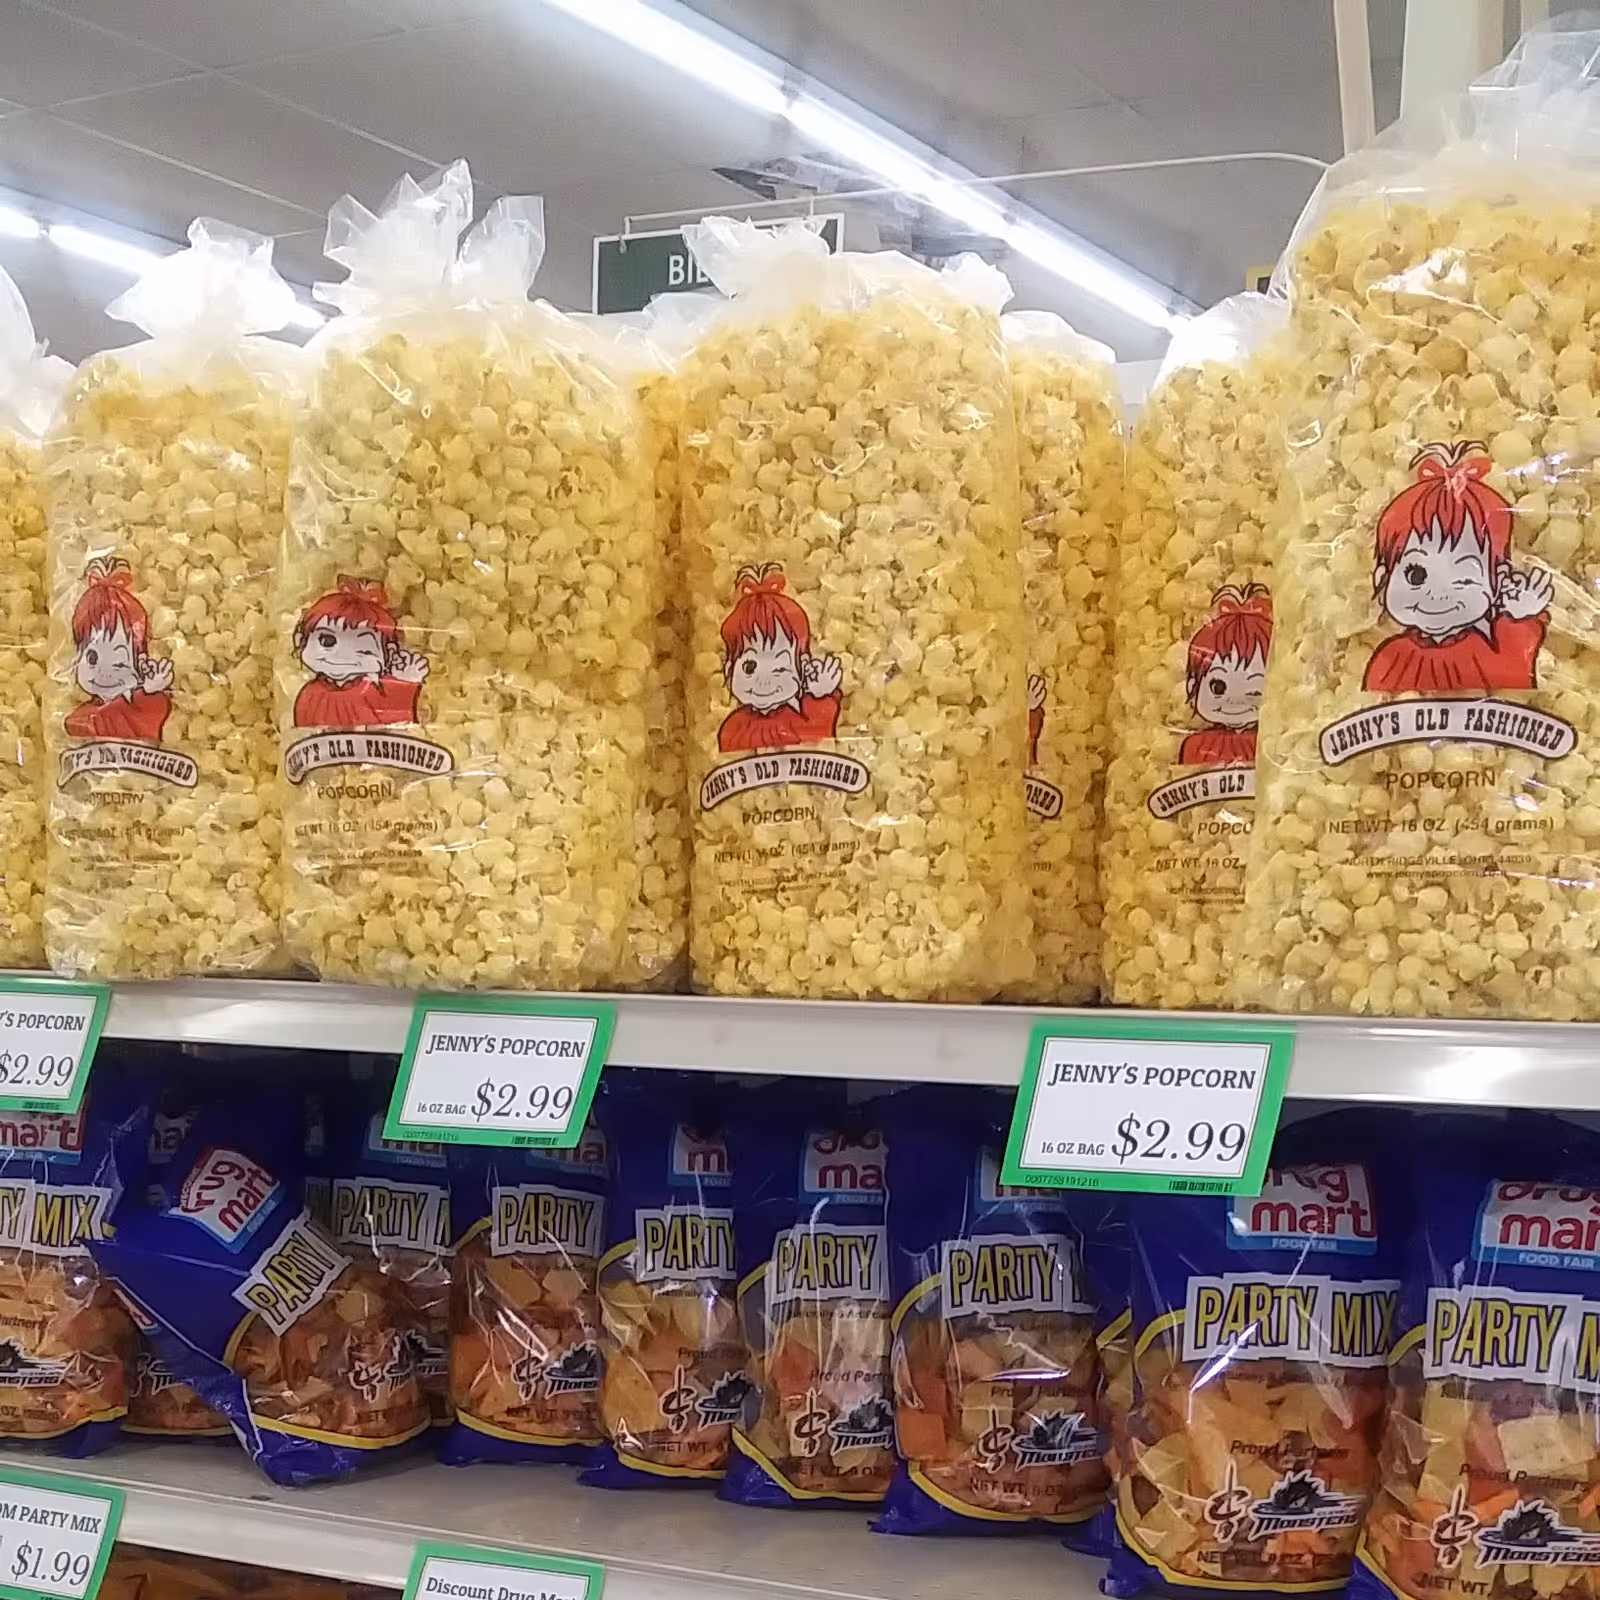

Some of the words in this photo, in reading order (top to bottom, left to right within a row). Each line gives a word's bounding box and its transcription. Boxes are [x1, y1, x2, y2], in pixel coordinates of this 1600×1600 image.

[1329, 711, 1401, 757] JENNY'S
[1415, 708, 1449, 732] OLD
[1464, 708, 1566, 752] FASHIONED
[328, 739, 355, 758] OLD
[366, 739, 445, 772] FASHIONED
[317, 781, 392, 799] POPCORN
[706, 765, 747, 802] JENNY'S
[754, 757, 780, 779] OLD
[788, 755, 860, 786] FASHIONED
[1156, 777, 1210, 813] JENNY'S
[1218, 773, 1245, 794] OLD
[1386, 770, 1496, 791] POPCORN
[742, 805, 815, 826] POPCORN
[1329, 820, 1359, 834] NET
[1400, 818, 1418, 832] 16
[1495, 816, 1554, 836] grams)
[16, 1012, 86, 1031] POPCORN
[425, 1033, 496, 1056] JENNY'S
[500, 1036, 585, 1059] POPCORN
[0, 1049, 74, 1087] $2.99
[1047, 1062, 1139, 1087] JENNY'S
[1142, 1066, 1257, 1090] POPCORN
[416, 1102, 430, 1114] 16
[431, 1103, 445, 1114] OZ
[445, 1103, 467, 1117] BAG
[470, 1078, 573, 1122] $2.99
[1041, 1141, 1054, 1154] 16
[1056, 1141, 1075, 1155] OZ
[1077, 1142, 1106, 1156] BAG
[1111, 1112, 1247, 1165] $2.99
[32, 1193, 101, 1248] MIX
[217, 1169, 280, 1234] mart
[335, 1187, 424, 1242] PARTY
[500, 1195, 594, 1248] PARTY
[1250, 1199, 1378, 1239] mart
[644, 1216, 737, 1273] PARTY
[777, 1234, 877, 1291] PARTY
[1518, 1251, 1559, 1266] FOOD
[1563, 1254, 1595, 1270] FAIR
[247, 1236, 322, 1325] PARTY
[951, 1244, 1057, 1308] PARTY
[1196, 1283, 1319, 1352] PARTY
[1330, 1291, 1399, 1358] MIX
[1432, 1297, 1567, 1374] PARTY
[19, 1505, 69, 1529] PARTY
[70, 1514, 102, 1535] MIX
[11, 1540, 90, 1586] $1.99
[425, 1576, 495, 1600] Discount
